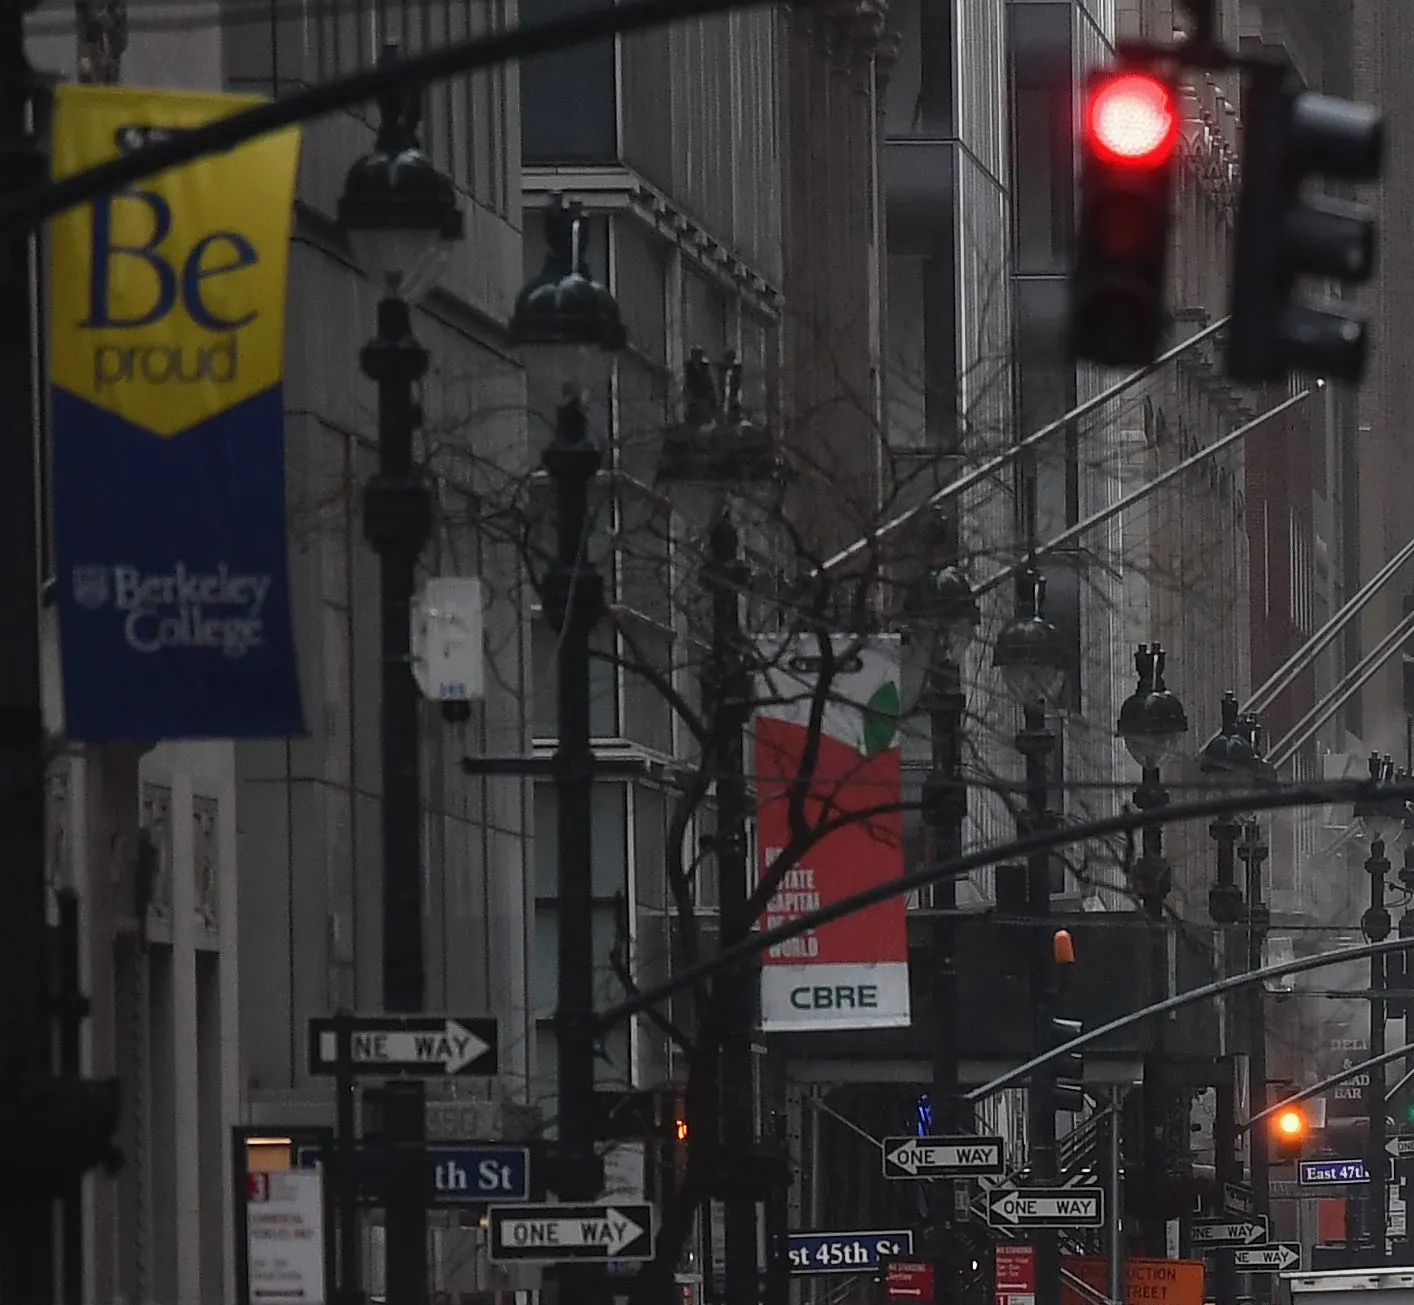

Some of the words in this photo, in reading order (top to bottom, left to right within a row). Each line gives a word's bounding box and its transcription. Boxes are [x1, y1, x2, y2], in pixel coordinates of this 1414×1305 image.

[78, 190, 262, 332] Be
[94, 335, 238, 390] proud
[116, 561, 272, 616] Berkeley
[124, 605, 265, 658] College
[791, 986, 877, 1009] CBRE
[353, 1035, 388, 1058] NE
[414, 1037, 471, 1058] WAY
[1334, 1088, 1361, 1099] BAR
[897, 1149, 934, 1164] ONE
[956, 1148, 992, 1163] WAY
[435, 1160, 467, 1190] th
[478, 1160, 513, 1190] St
[1306, 1167, 1336, 1180] East
[1003, 1201, 1036, 1215] ONE
[1056, 1199, 1091, 1214] WAY
[513, 1223, 558, 1242] ONE
[580, 1222, 628, 1242] WAY
[1227, 1226, 1254, 1237] WAY
[788, 1246, 809, 1267] st
[815, 1242, 868, 1265] 45th
[876, 1240, 902, 1265] St
[1235, 1252, 1249, 1263] NE
[1263, 1252, 1289, 1262] WAY
[1126, 1285, 1168, 1299] TREET
